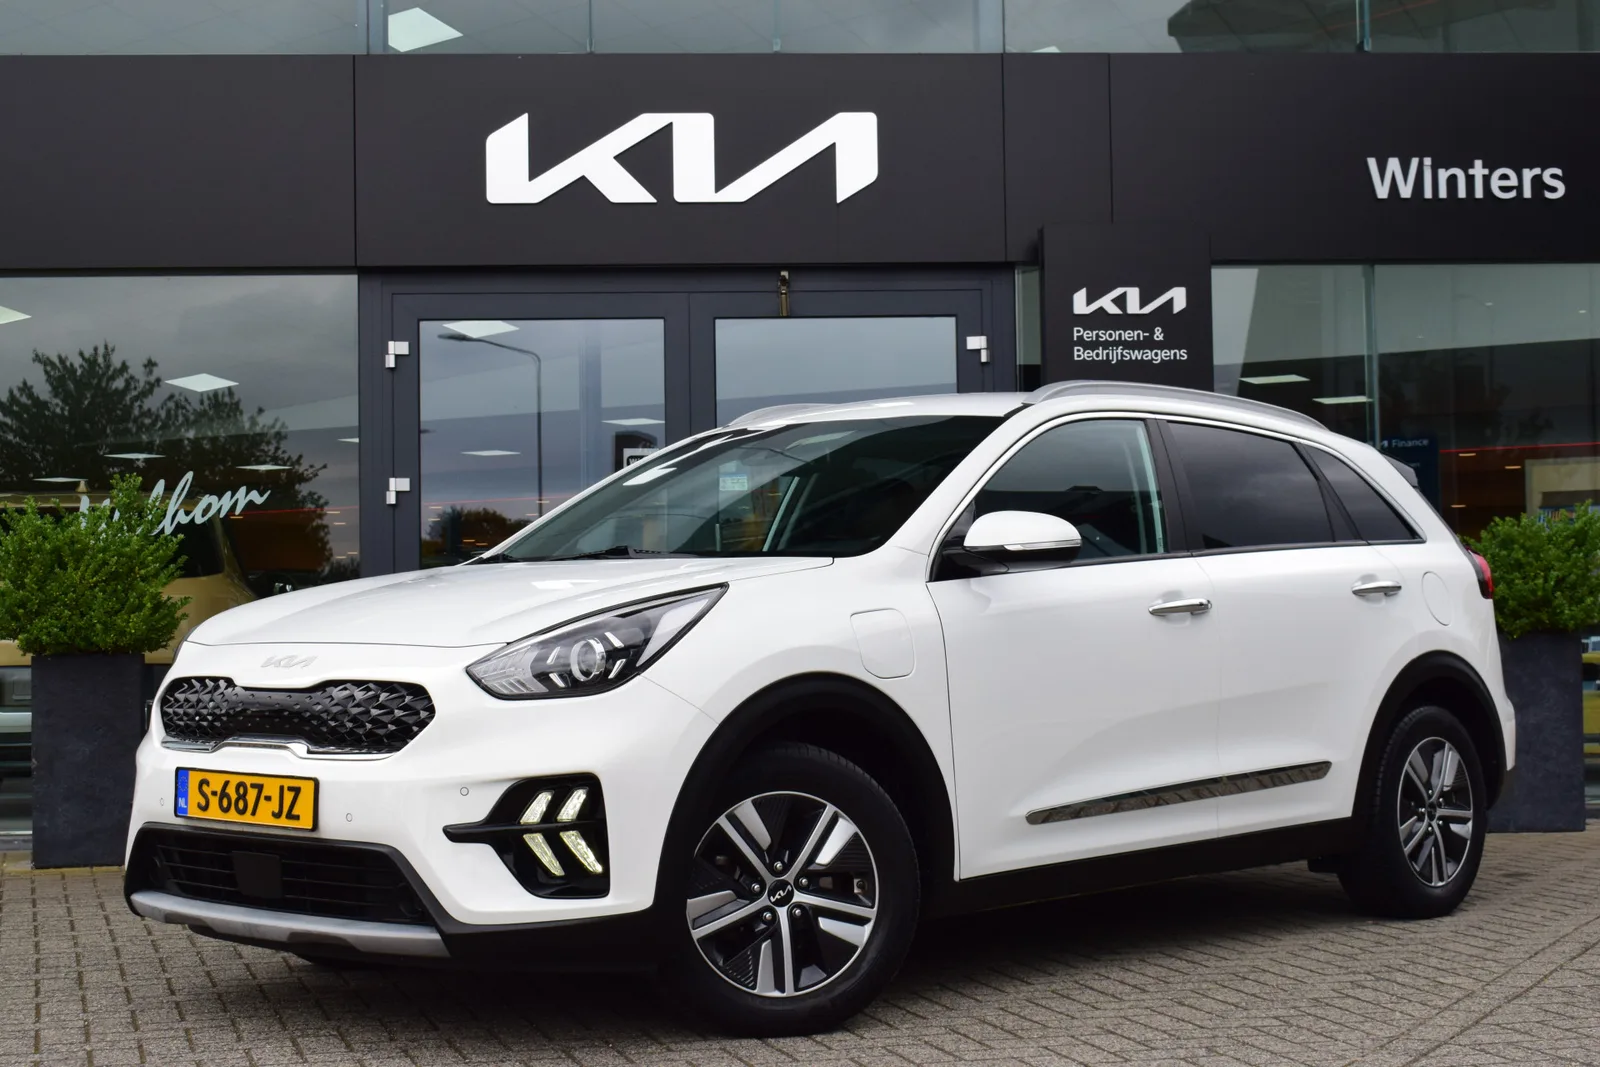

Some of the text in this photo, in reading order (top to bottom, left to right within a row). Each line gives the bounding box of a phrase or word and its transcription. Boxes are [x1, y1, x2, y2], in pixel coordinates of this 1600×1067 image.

[486, 112, 878, 204] KIA
[1366, 157, 1566, 200] Winters
[1073, 286, 1187, 315] KIA
[1073, 326, 1164, 341] Personen- &
[1073, 346, 1188, 364] Bedrijfswagens
[1391, 439, 1429, 448] Finance
[178, 797, 188, 809] NL
[197, 778, 302, 821] S-687-JZ
[770, 884, 793, 903] KIA
